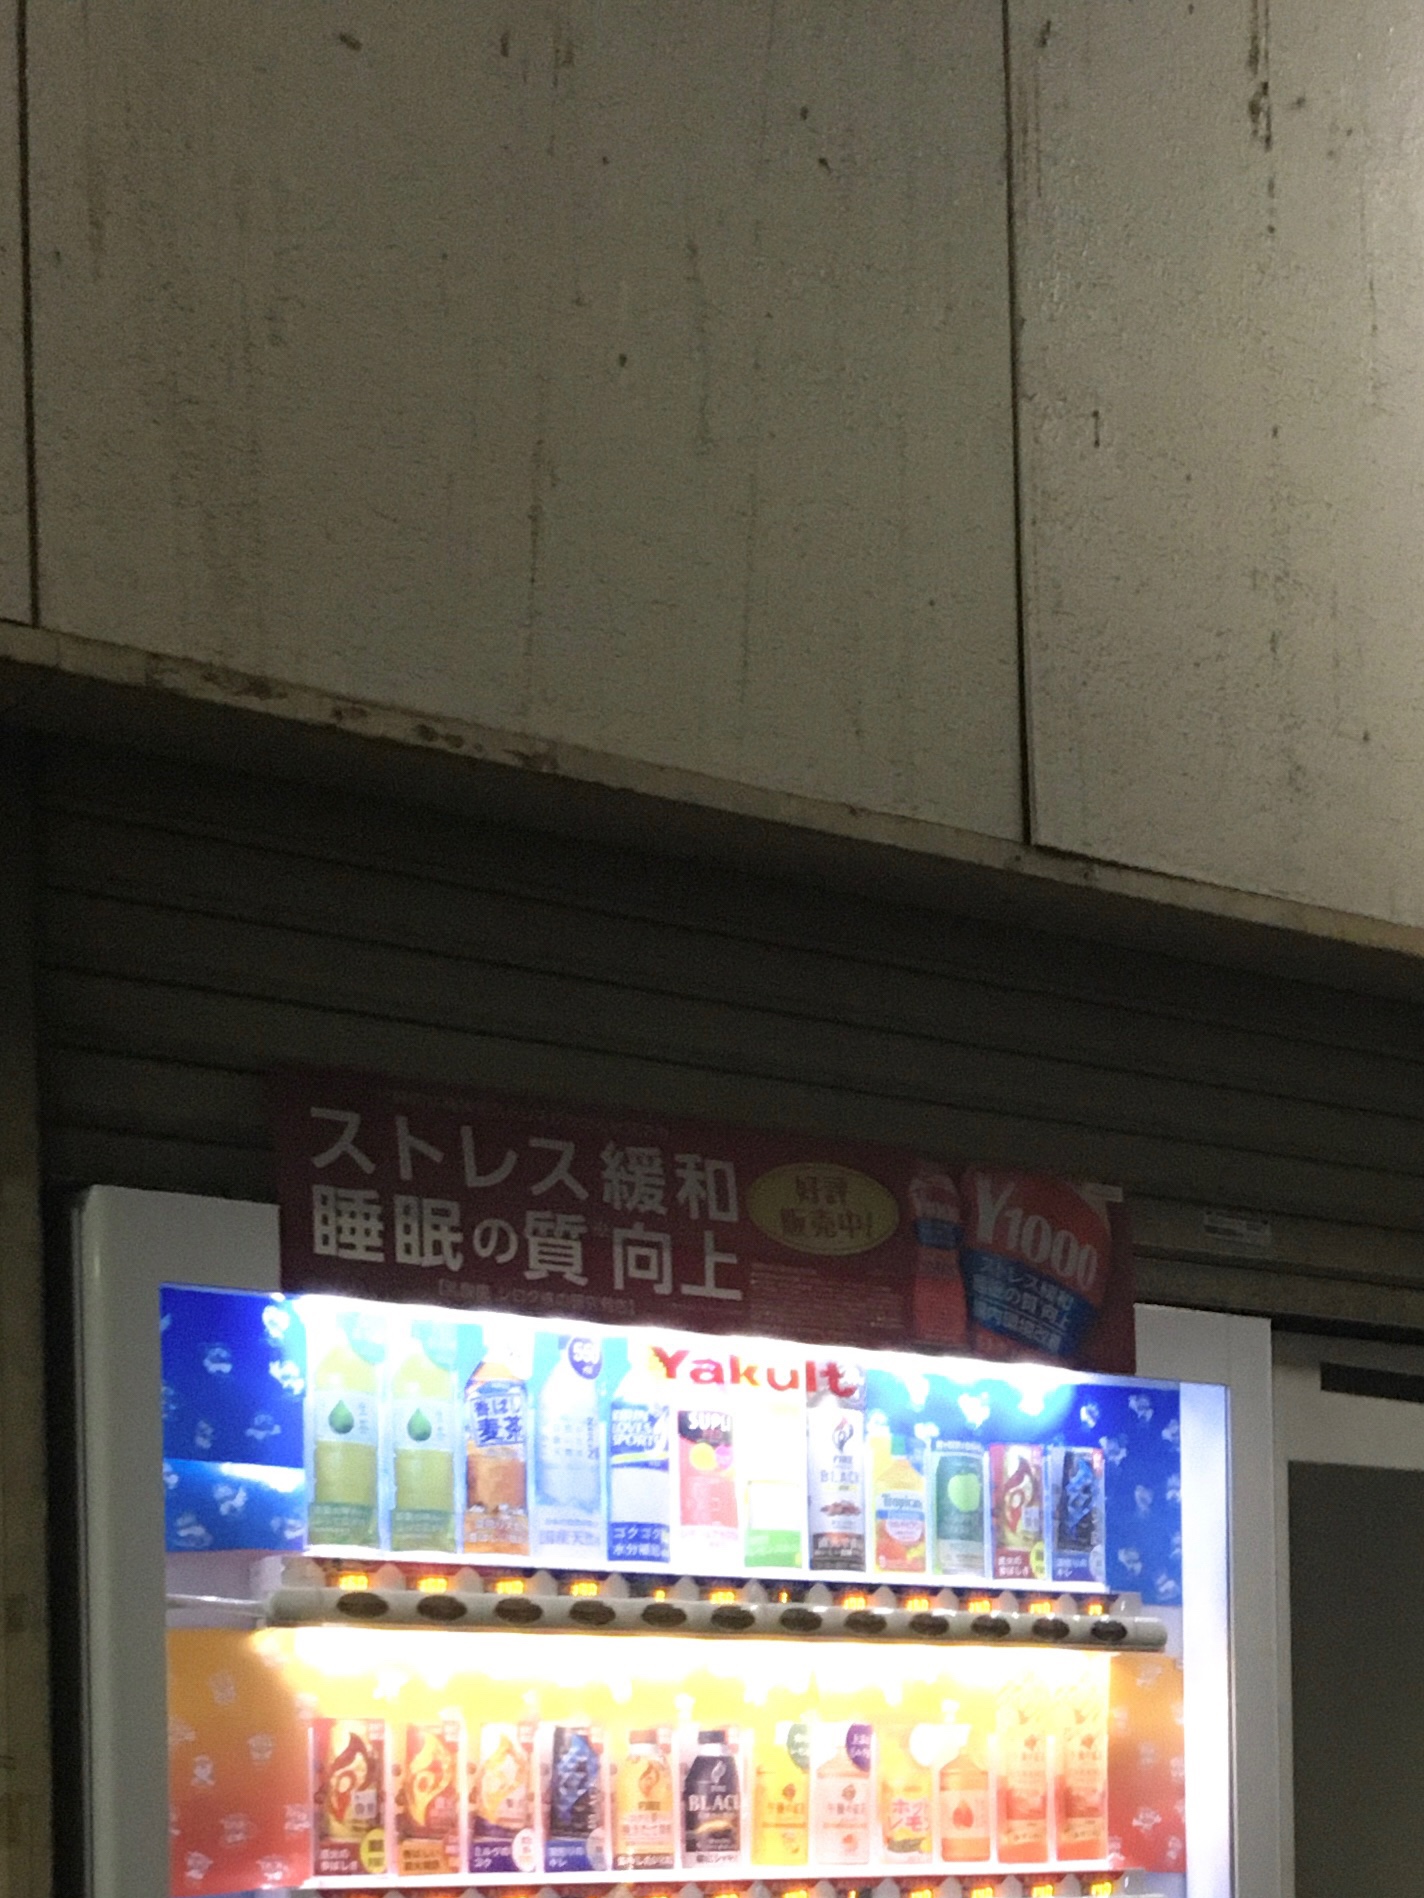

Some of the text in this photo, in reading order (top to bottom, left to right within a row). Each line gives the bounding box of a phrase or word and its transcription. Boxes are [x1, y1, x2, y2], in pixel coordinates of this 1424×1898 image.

[310, 1106, 739, 1222] ストレス緩和
[312, 1183, 743, 1300] 睡眠の質向上
[976, 1171, 1099, 1290] Y1000
[649, 1345, 858, 1399] Yakult
